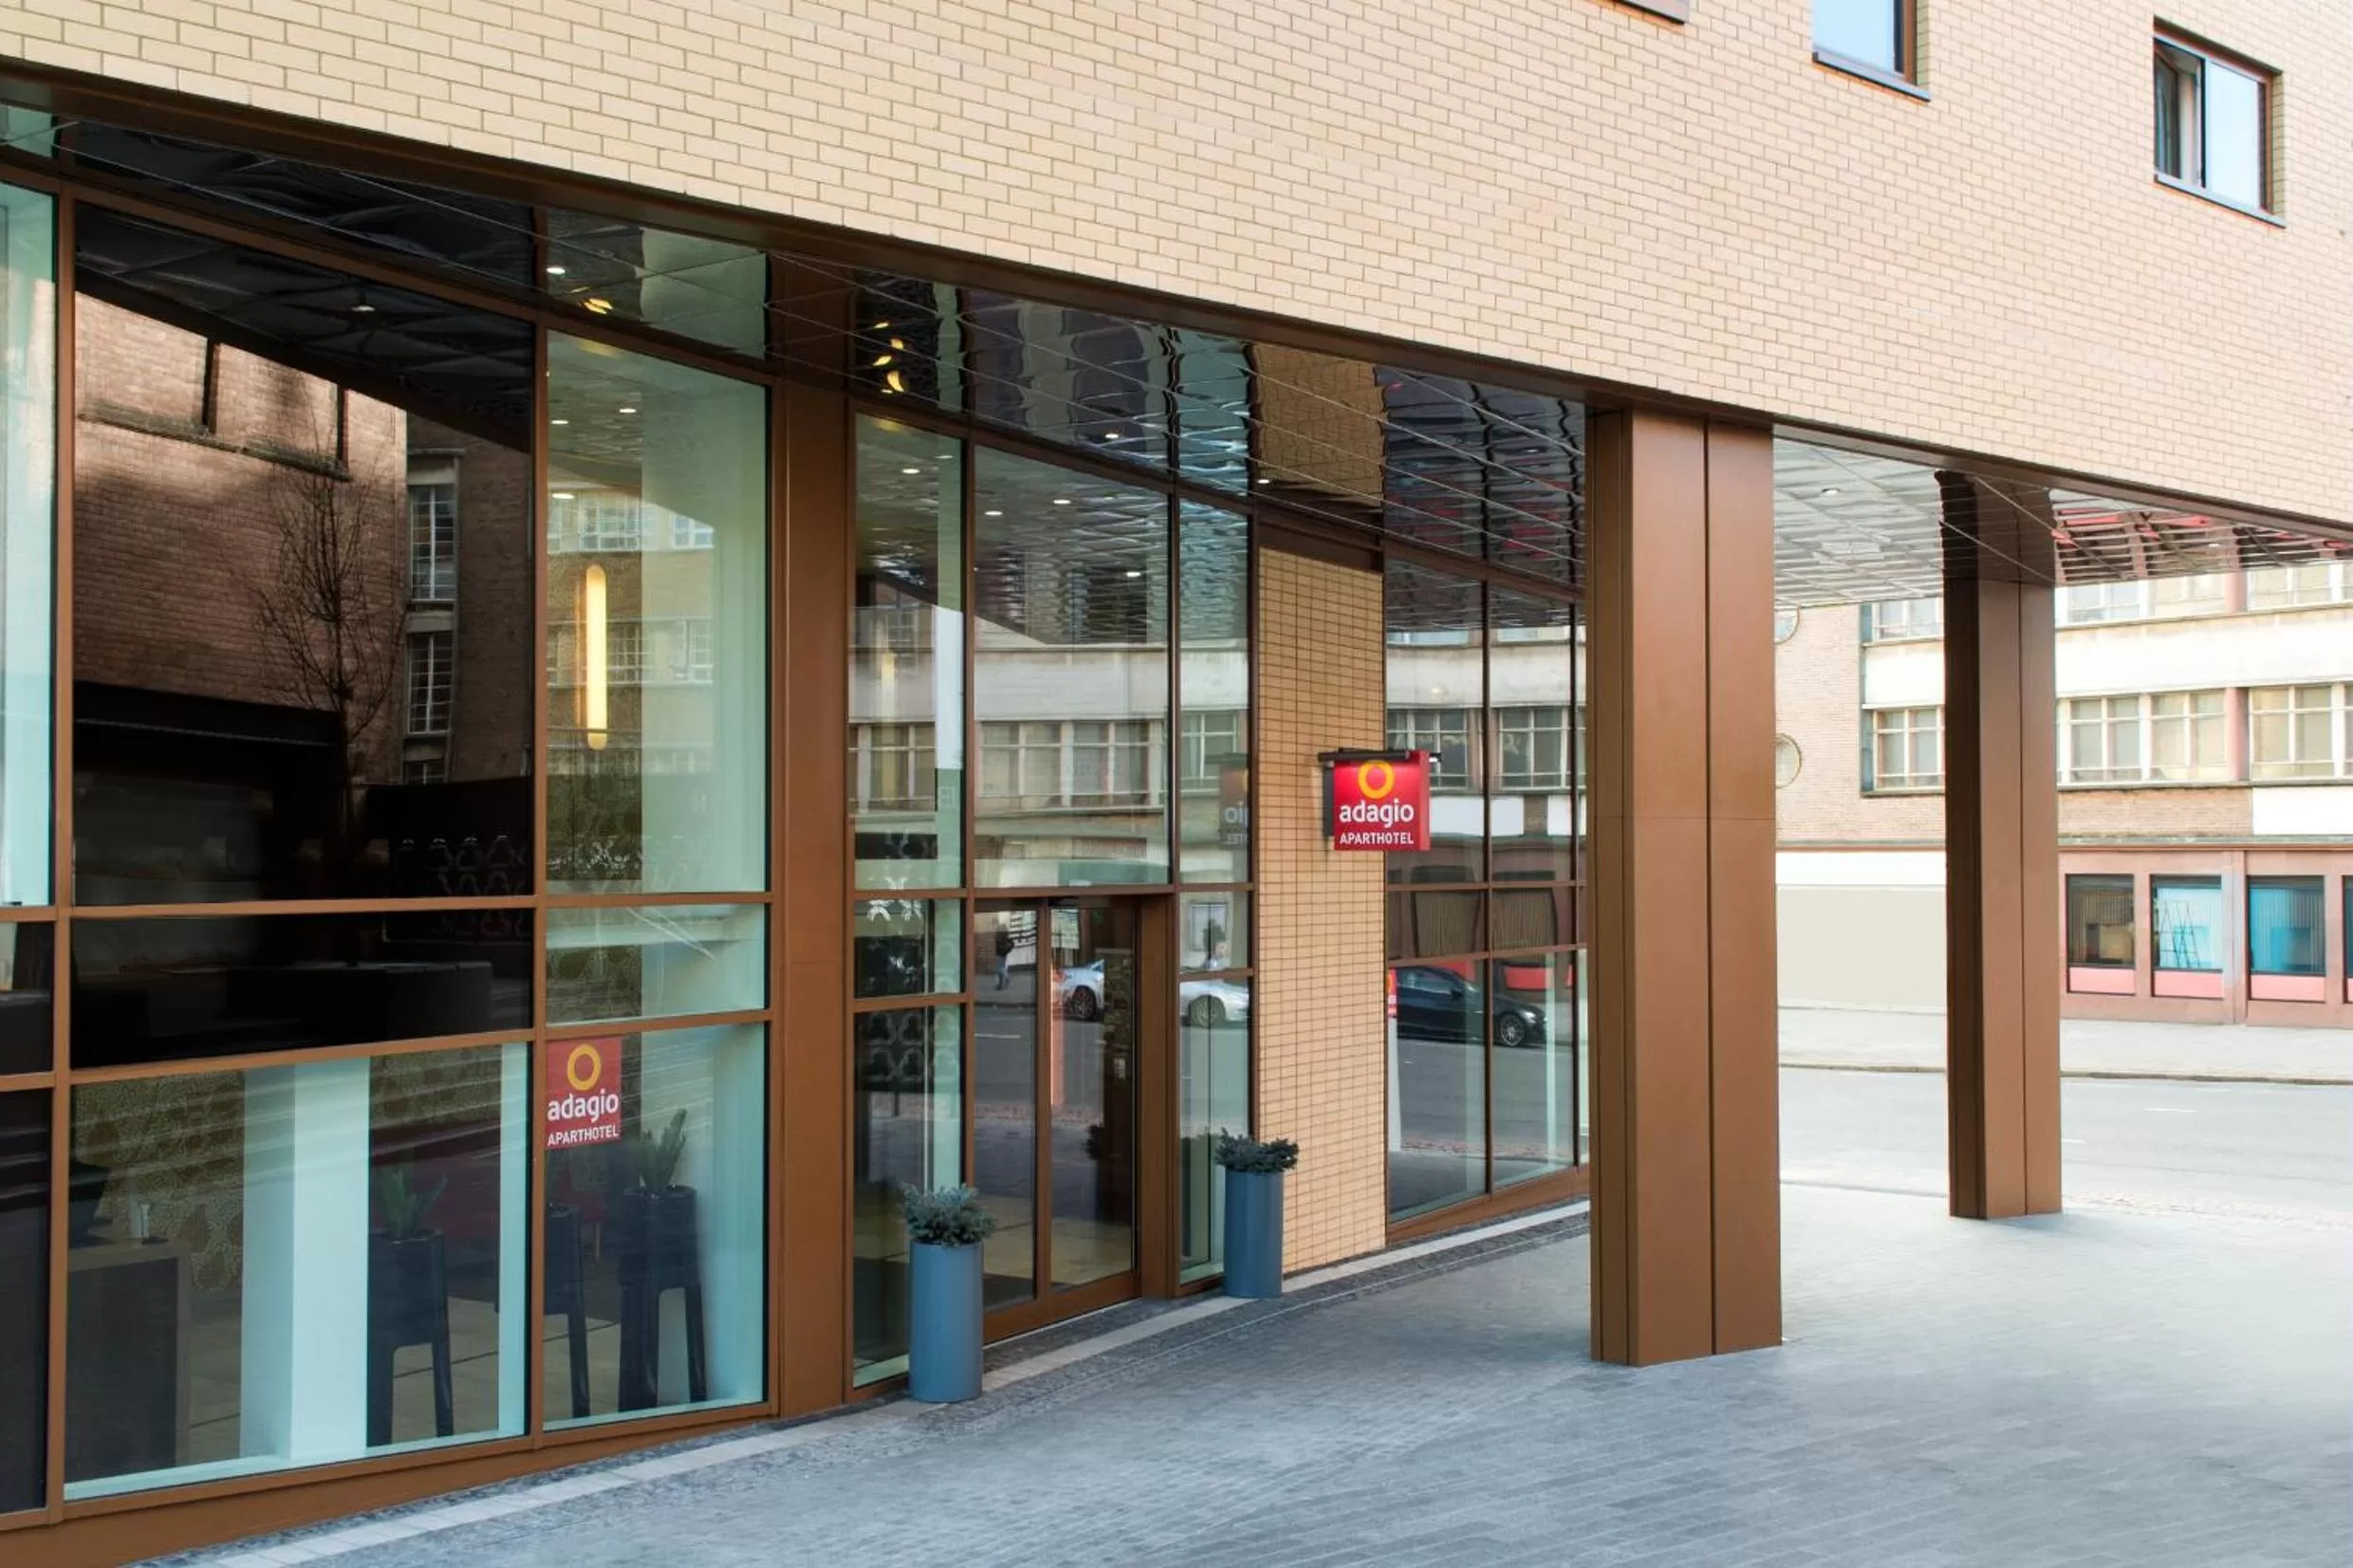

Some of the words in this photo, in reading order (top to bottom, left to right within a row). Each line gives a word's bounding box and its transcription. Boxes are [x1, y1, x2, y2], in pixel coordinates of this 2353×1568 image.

[1339, 798, 1415, 828] adagio
[1340, 832, 1415, 845] APARTHOTEL
[547, 1088, 620, 1123] adagio
[547, 1124, 620, 1147] APARTHOTEL
